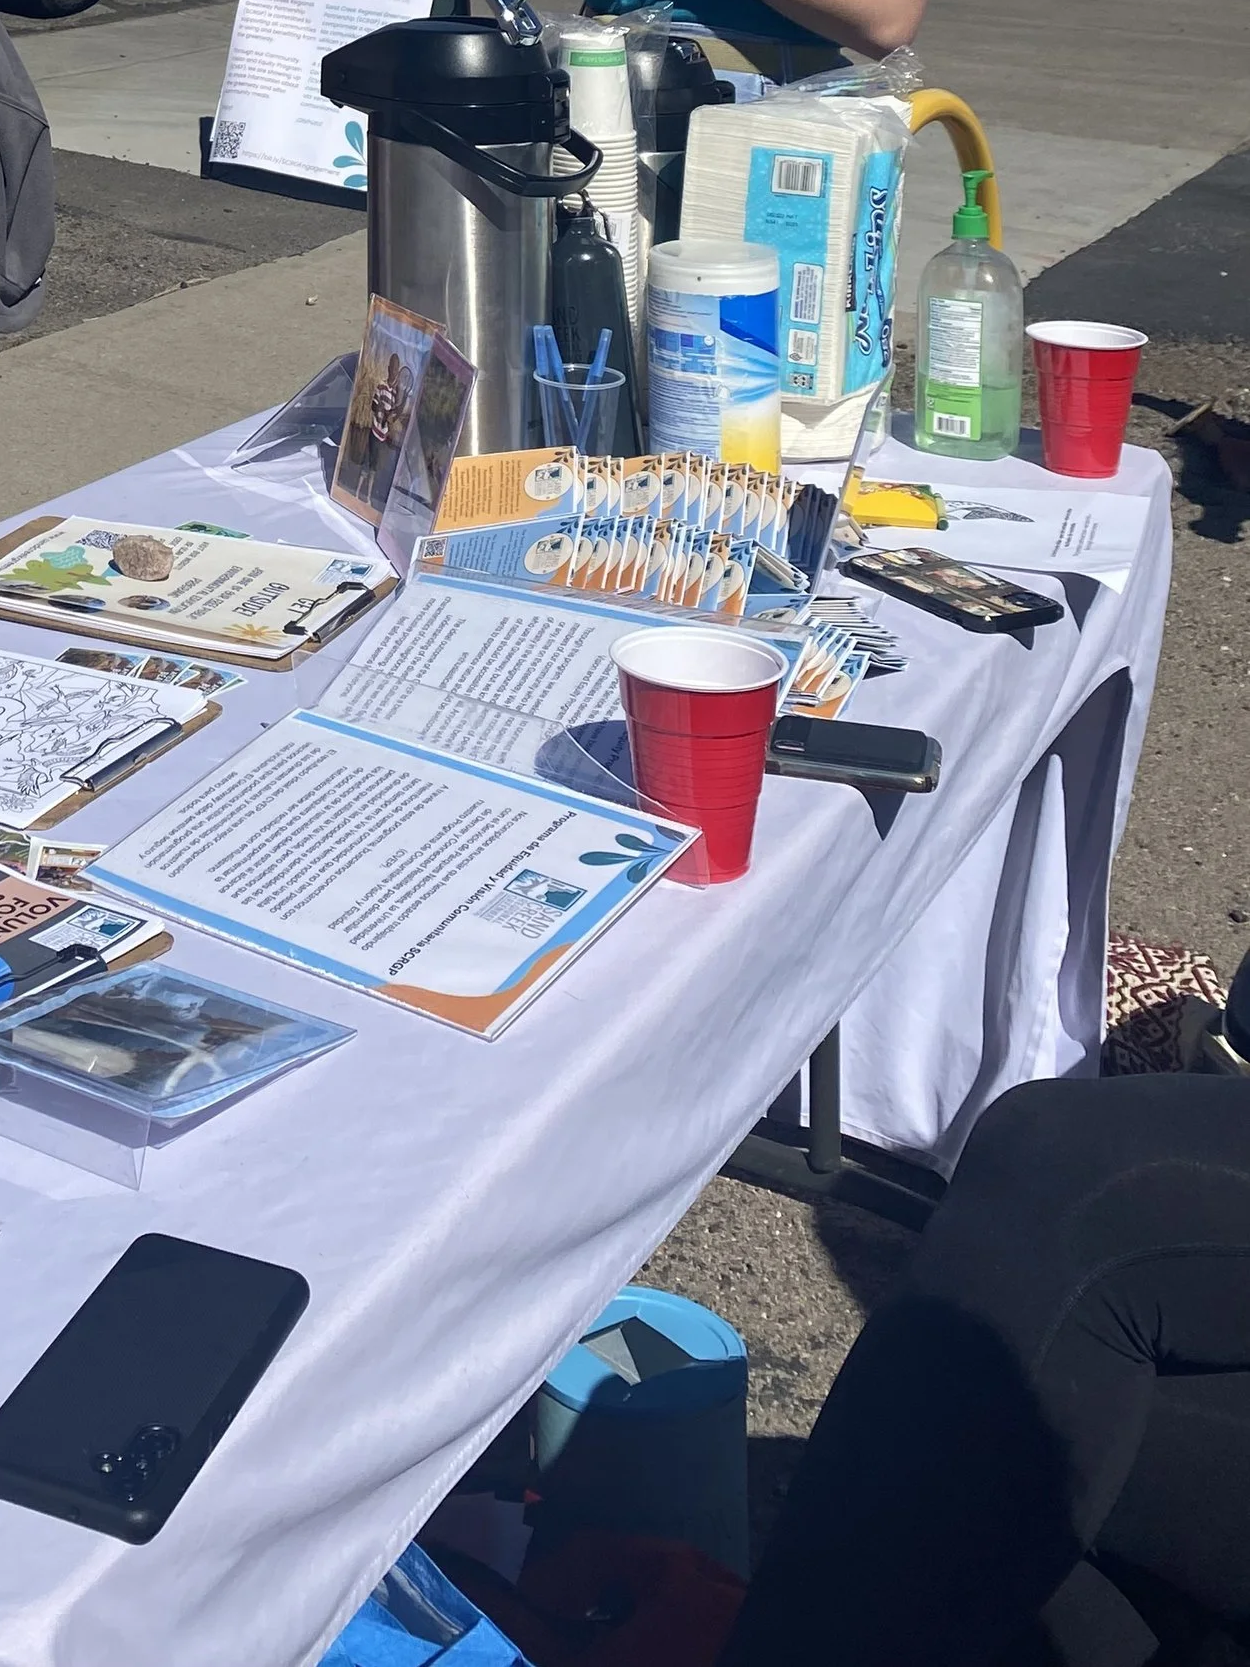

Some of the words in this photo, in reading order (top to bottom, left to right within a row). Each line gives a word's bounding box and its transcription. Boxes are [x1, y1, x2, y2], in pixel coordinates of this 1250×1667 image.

[233, 582, 289, 616] OUTSIDE!
[479, 808, 492, 816] de
[497, 807, 511, 818] con
[510, 810, 527, 821] Nos
[459, 815, 484, 834] Denver
[466, 823, 494, 843] Servicio
[482, 821, 513, 846] complace
[537, 811, 576, 840] Programa
[419, 838, 457, 868] Connected
[457, 843, 471, 851] de
[526, 841, 541, 850] de
[431, 850, 461, 873] Parques
[495, 850, 530, 878] Equidad
[439, 869, 457, 882] que
[375, 888, 395, 903] para
[419, 881, 445, 900] hemos
[465, 883, 494, 904] Visión
[343, 903, 379, 932] desarrollar
[397, 899, 422, 921] estado
[502, 902, 542, 931] CREEK
[349, 911, 391, 944] Universidad
[416, 904, 468, 946] Comunitaria
[521, 907, 562, 938] SAND
[387, 947, 420, 975] SCRGP
